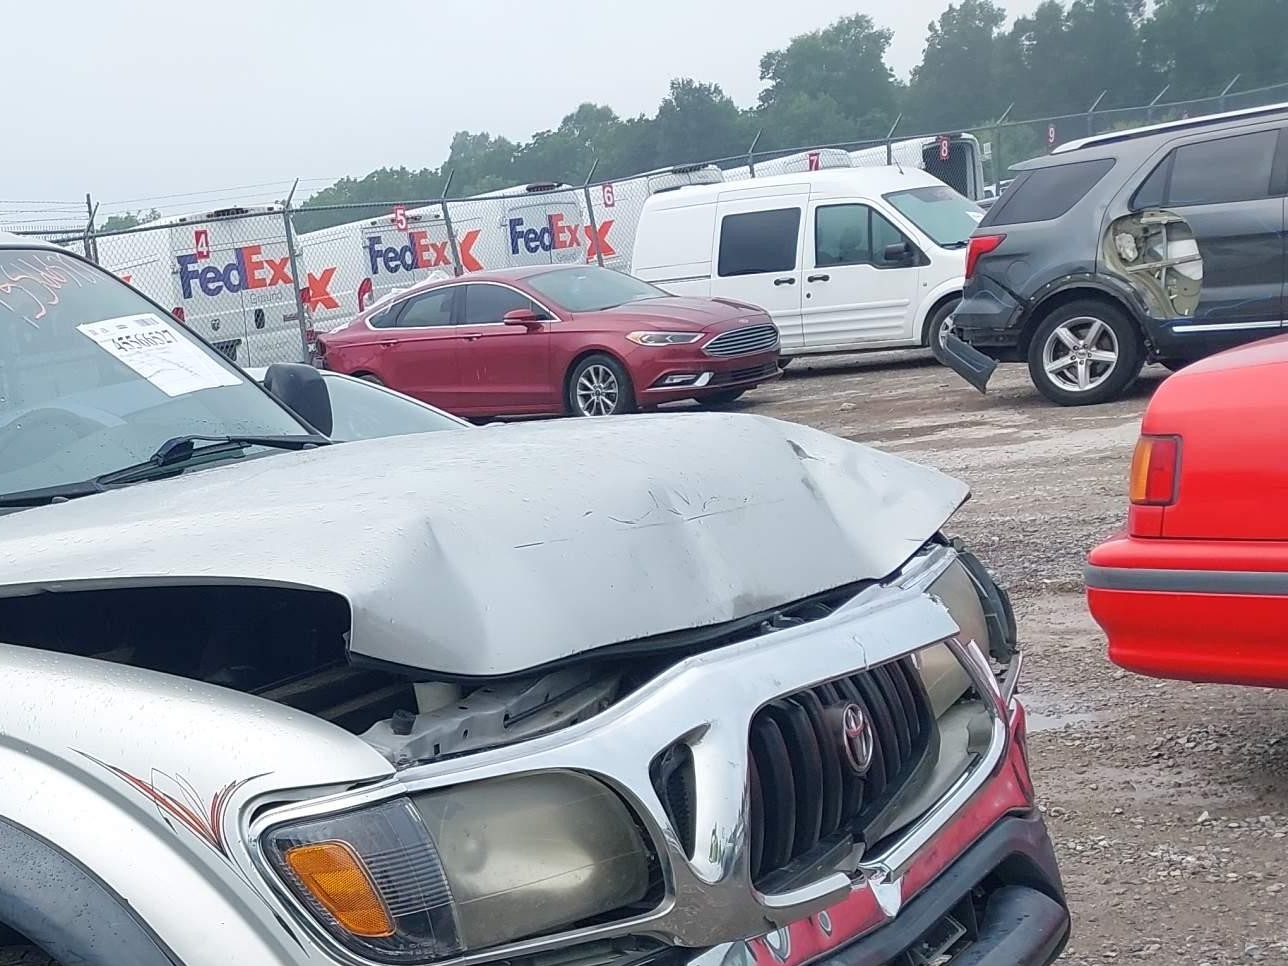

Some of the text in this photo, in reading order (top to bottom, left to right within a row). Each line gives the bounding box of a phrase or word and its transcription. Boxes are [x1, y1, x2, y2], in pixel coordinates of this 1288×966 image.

[1049, 127, 1056, 143] 9
[941, 140, 948, 157] 8
[810, 155, 818, 171] 7
[604, 186, 614, 206] 6
[396, 208, 406, 230] 5
[197, 233, 208, 256] 4
[508, 212, 581, 255] FedEx
[367, 230, 452, 275] FedEx
[176, 244, 295, 300] FedEx
